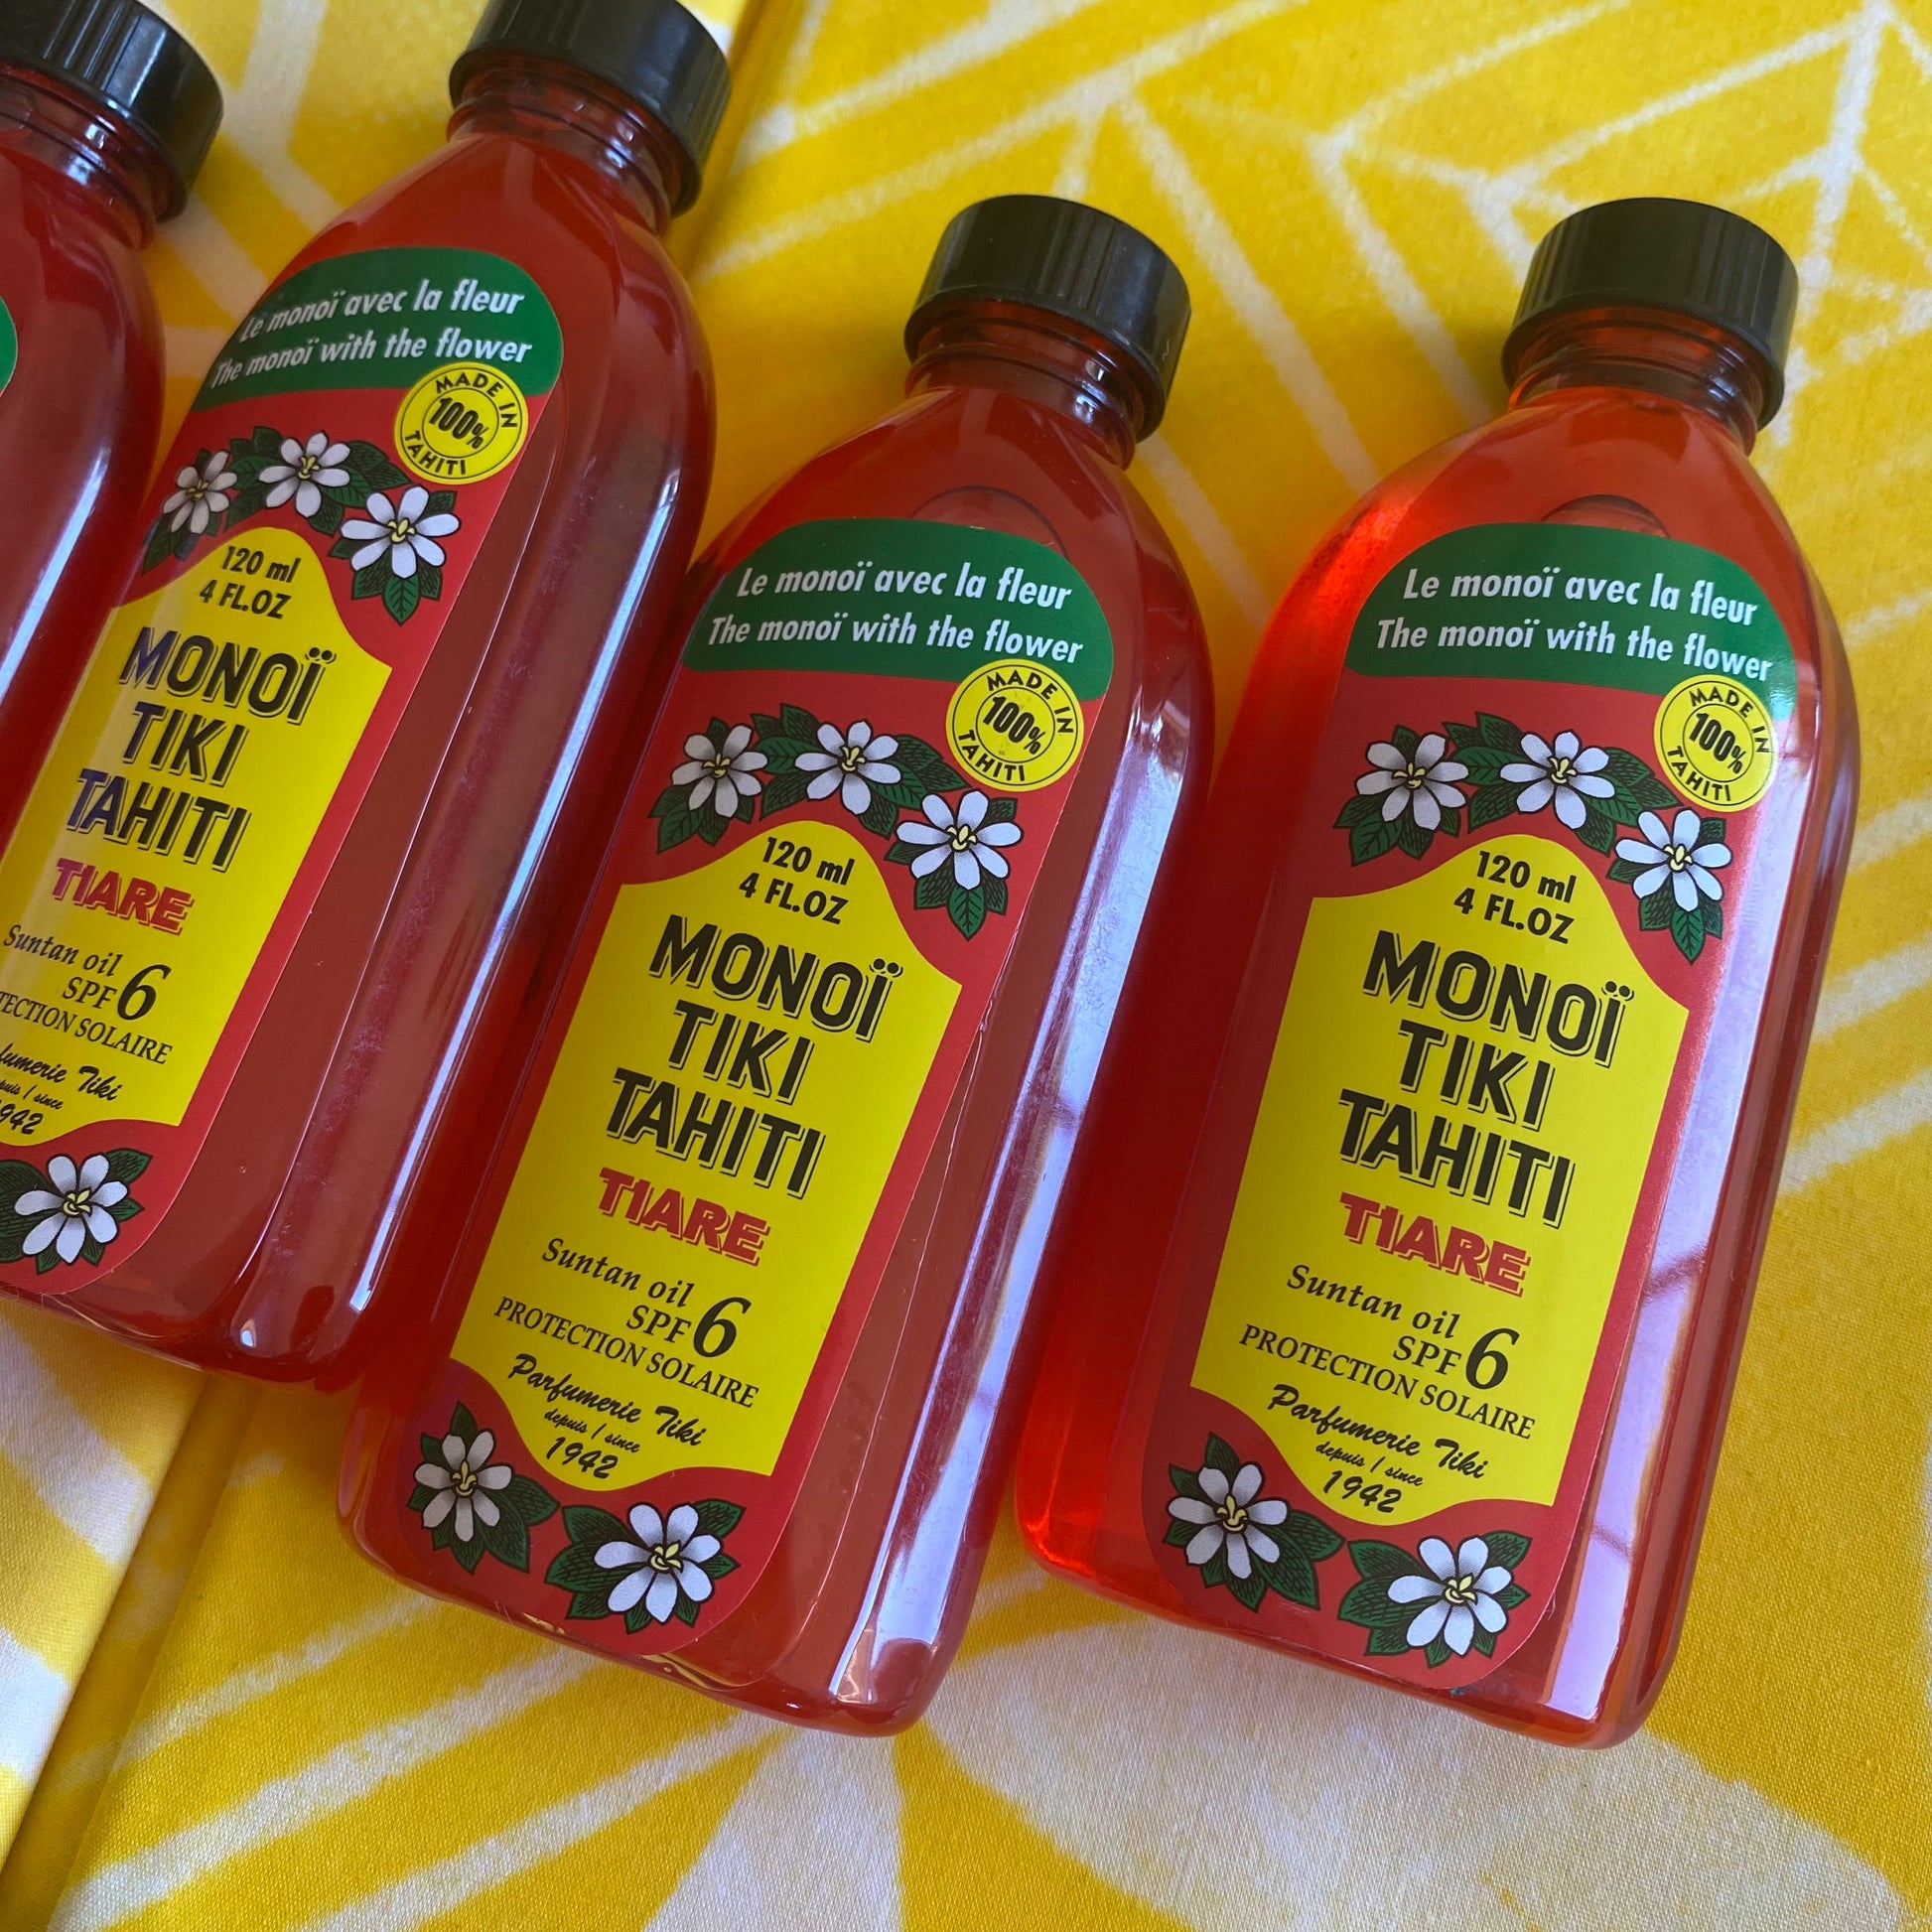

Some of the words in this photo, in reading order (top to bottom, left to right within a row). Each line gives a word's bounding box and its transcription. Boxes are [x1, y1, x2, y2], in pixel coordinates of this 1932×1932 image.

[238, 316, 265, 343] Le
[269, 289, 345, 332] monoï
[345, 289, 408, 317] avec
[413, 277, 443, 313] la
[450, 277, 525, 315] fleur
[210, 357, 243, 389] The
[246, 338, 320, 376] monoï
[320, 330, 377, 362] with
[384, 328, 427, 358] the
[434, 328, 532, 363] flower
[429, 397, 489, 450] 100%
[435, 372, 503, 398] MADE
[498, 402, 518, 428] IN
[405, 430, 467, 476] TAHITI
[220, 545, 264, 576] 120
[266, 558, 302, 584] ml
[737, 567, 767, 597] Le
[774, 560, 873, 593] monoï
[875, 569, 947, 597] avec
[954, 561, 986, 599] la
[996, 567, 1072, 611] fleur
[199, 579, 215, 604] 4
[218, 583, 292, 620] FL.OZ
[1402, 568, 1440, 601] Le
[1449, 567, 1561, 601] monoï
[1565, 577, 1641, 607] avec
[1649, 573, 1680, 611] la
[1690, 579, 1759, 627] fleur
[707, 617, 752, 646] The
[757, 612, 848, 641] monoï
[852, 612, 916, 644] with
[926, 619, 973, 649] the
[983, 619, 1084, 663] flower
[1376, 619, 1429, 649] The
[1438, 618, 1540, 649] monoï
[1546, 621, 1616, 655] with
[1626, 626, 1674, 662] the
[1683, 635, 1773, 682] flower
[118, 626, 337, 726] MONOÏ
[986, 669, 1058, 700] MADE
[1053, 706, 1074, 733] IN
[122, 701, 249, 788] TIKI
[982, 696, 1046, 755] 100%
[1689, 686, 1754, 719] MADE
[1751, 725, 1770, 753] IN
[1689, 713, 1746, 774] 100%
[958, 729, 1025, 782] TAHITI
[1667, 746, 1731, 801] TAHITI
[66, 767, 252, 874] TAHITI
[761, 835, 812, 874] 120
[816, 857, 856, 887] ml
[1476, 849, 1531, 890] 120
[1538, 873, 1577, 903] ml
[51, 858, 195, 935] TIARE
[739, 872, 757, 898] 4
[765, 878, 850, 925] FL.OZ
[1453, 887, 1473, 915] 4
[1484, 899, 1575, 945] FL.OZ
[4, 924, 79, 965] Suntan
[82, 952, 123, 977] oil
[648, 913, 904, 1043] MONOÏ
[63, 976, 118, 1010] SPF
[116, 964, 172, 1021] 6
[1361, 929, 1635, 1069] MONOÏ
[75, 1018, 173, 1065] SOLAIRE
[667, 999, 816, 1106] TIKI
[34, 1093, 64, 1110] since
[77, 1065, 123, 1101] Tiki
[1398, 1019, 1556, 1133] TIKI
[0, 1099, 44, 1135] 942
[606, 1066, 827, 1201] TAHITI
[1338, 1088, 1576, 1230] TAHITI
[598, 1167, 770, 1267] TIARE
[1340, 1192, 1532, 1298] TIARE
[542, 1237, 642, 1292] Suntan
[647, 1280, 696, 1309] oil
[1287, 1265, 1403, 1321] Suntan
[1412, 1310, 1460, 1339] oil
[493, 1296, 648, 1368] PROTECTION
[645, 1351, 760, 1409] SOLAIRE
[625, 1305, 693, 1344] SPF
[692, 1297, 753, 1358] 6
[1239, 1323, 1419, 1399] PROTECTION
[1420, 1384, 1536, 1440] SOLAIRE
[1392, 1335, 1461, 1376] SPF
[1464, 1327, 1520, 1390] 6
[507, 1353, 642, 1424] Parfumerie
[654, 1405, 707, 1447] Tiki
[544, 1408, 588, 1434] depuis
[604, 1433, 640, 1453] since
[546, 1436, 619, 1479] 1942
[1267, 1383, 1421, 1456] Parfumerie
[1434, 1439, 1489, 1479] Tiki
[1315, 1442, 1365, 1467] depuis
[1385, 1465, 1424, 1487] since
[1322, 1469, 1402, 1513] 1942
